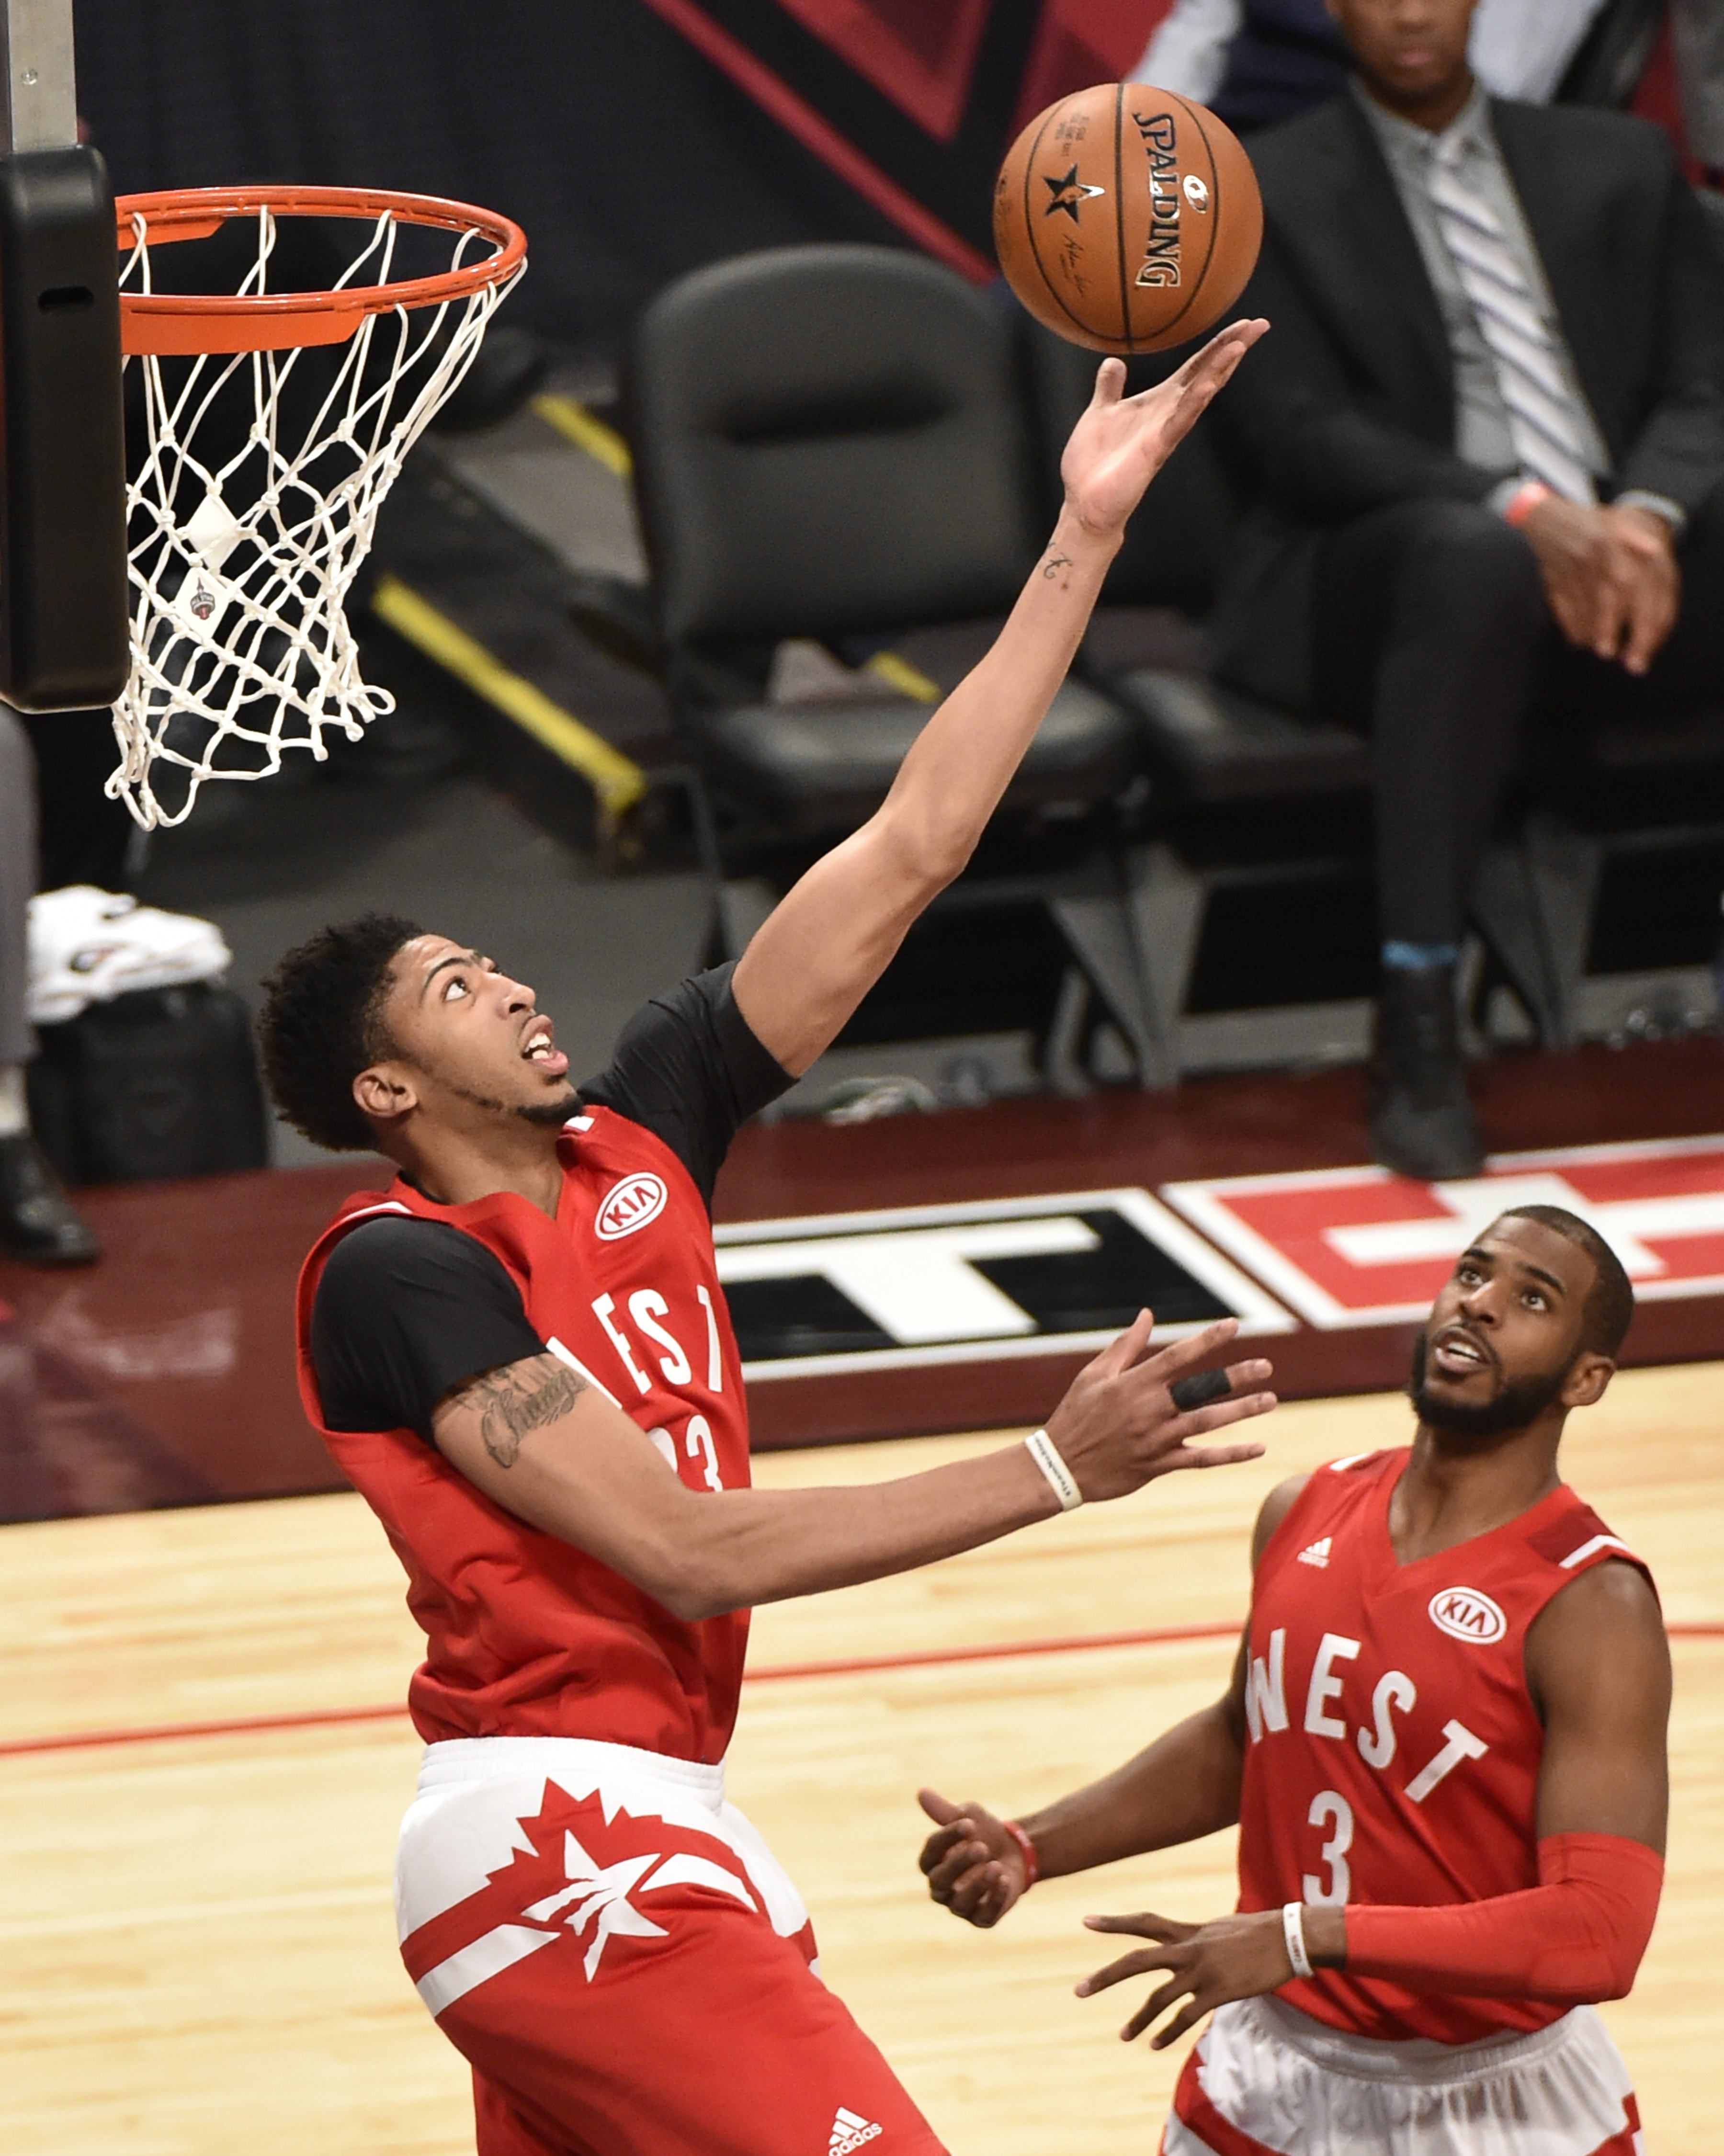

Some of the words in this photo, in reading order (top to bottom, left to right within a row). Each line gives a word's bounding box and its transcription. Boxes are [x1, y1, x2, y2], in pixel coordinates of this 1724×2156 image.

[1132, 112, 1181, 288] SPALDING
[606, 1185, 657, 1227] KIA
[546, 1284, 723, 1409] EST
[646, 1415, 723, 1492] 3
[1442, 1595, 1486, 1634] KIA
[1246, 1628, 1489, 1803] WEST
[1302, 1790, 1354, 1907] 3
[828, 2122, 883, 2156] adidas
